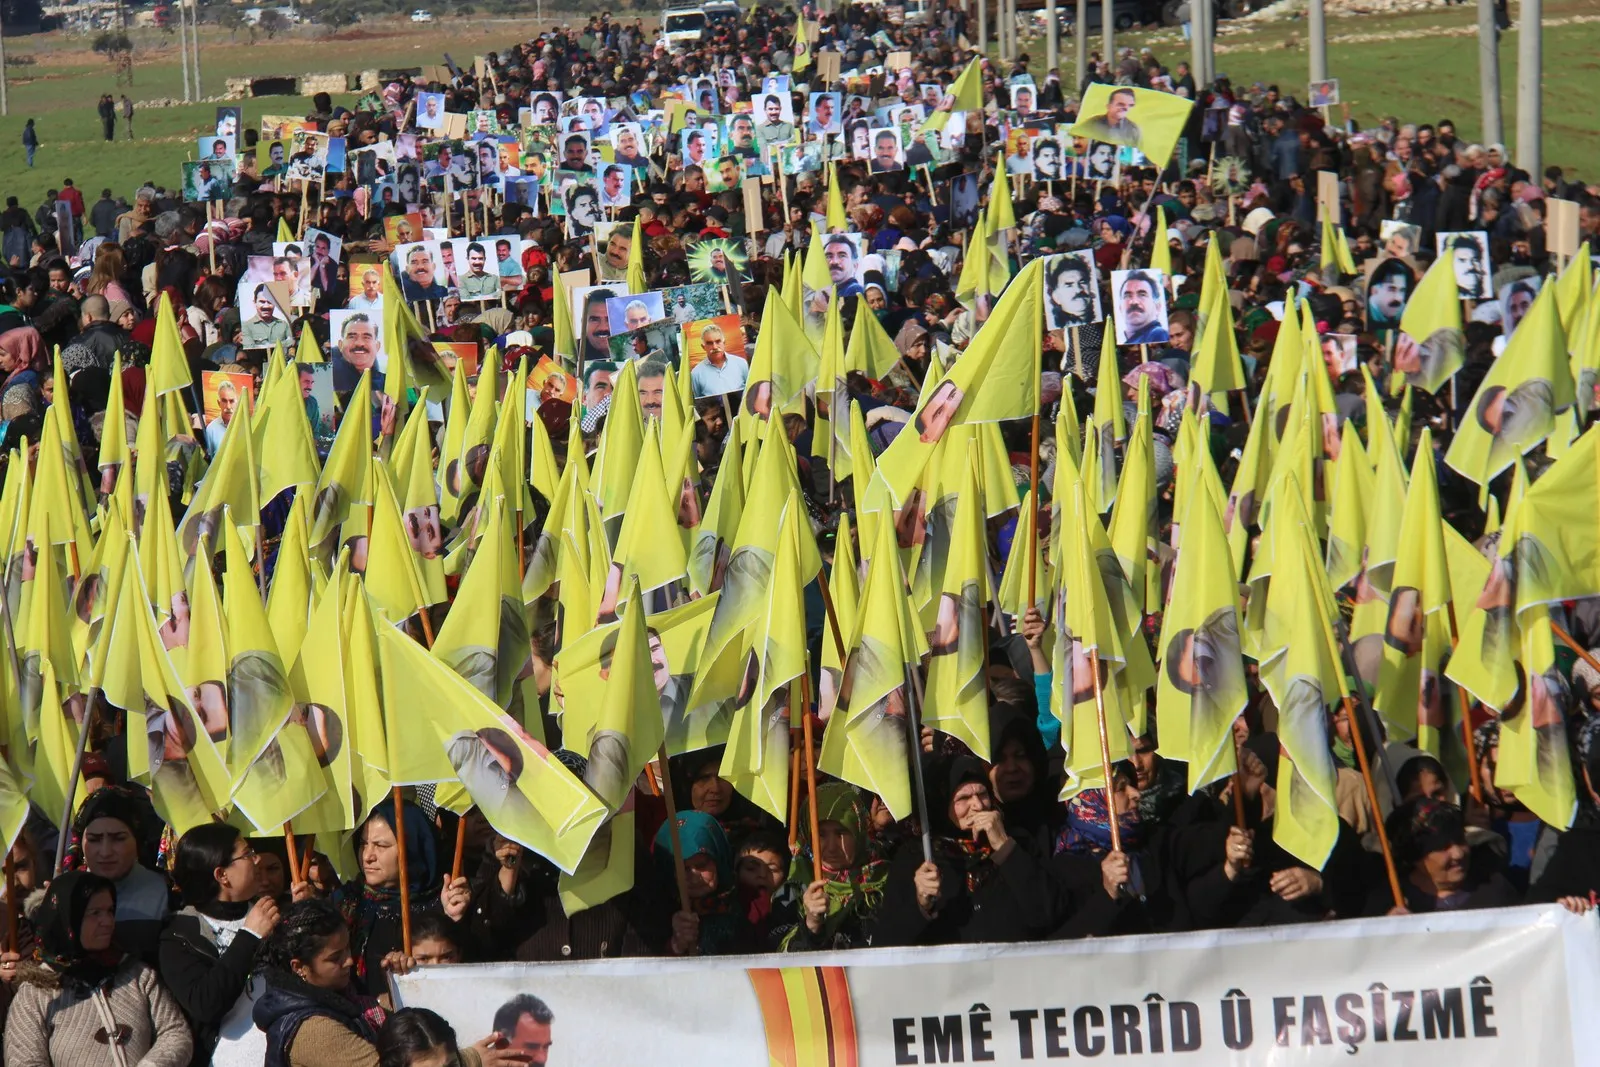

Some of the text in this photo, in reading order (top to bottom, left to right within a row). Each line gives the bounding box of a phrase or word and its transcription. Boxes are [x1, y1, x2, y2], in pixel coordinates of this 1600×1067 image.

[893, 976, 1498, 1065] EMÊ TECRÎD Û FAŞÎZMÊ
